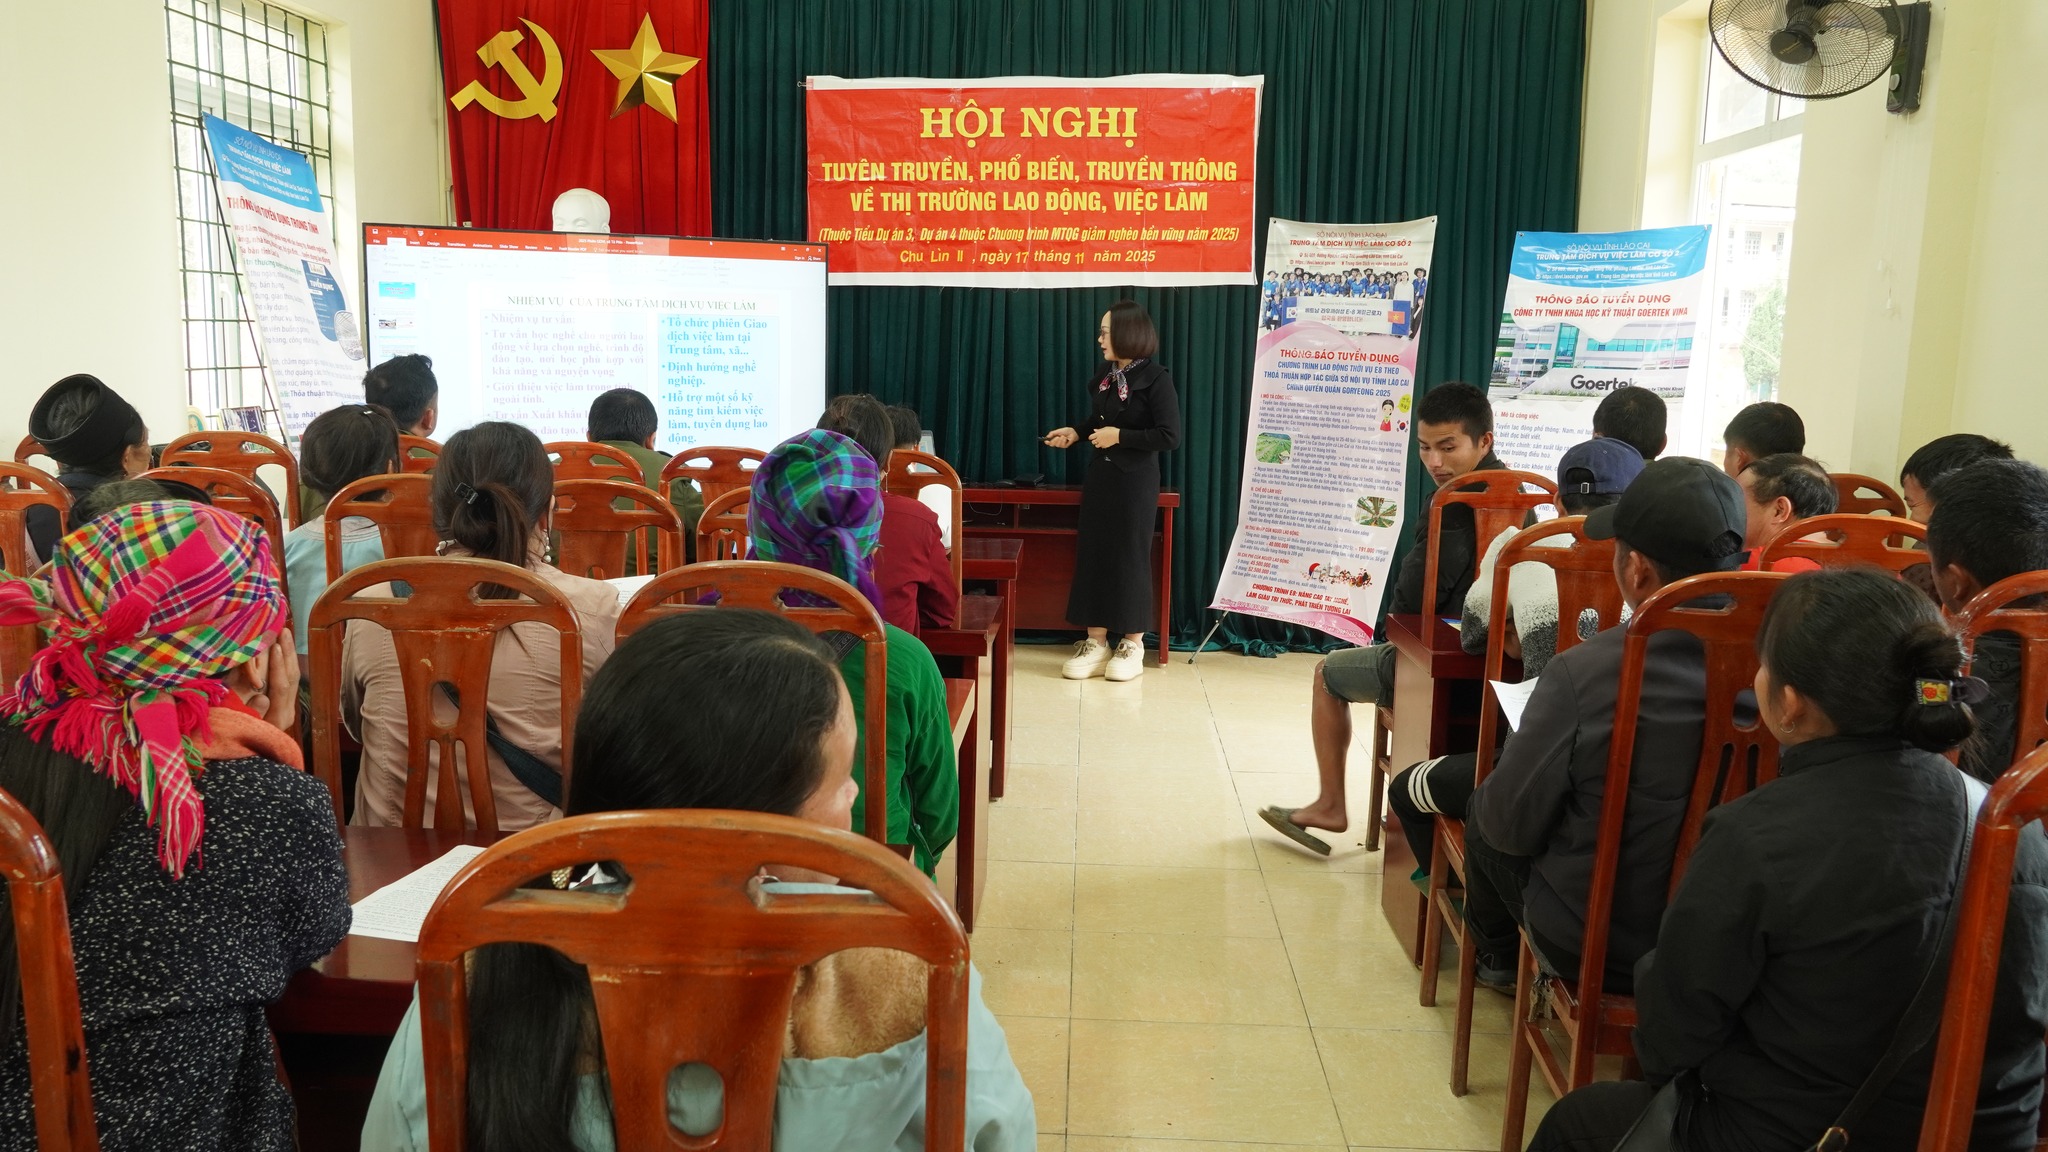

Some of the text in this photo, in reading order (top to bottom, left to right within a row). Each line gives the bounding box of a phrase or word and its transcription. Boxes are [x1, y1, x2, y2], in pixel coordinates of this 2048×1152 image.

[920, 98, 1138, 148] HỘI NGHỊ
[822, 154, 1238, 183] TUYÊN TRUYỀN, PHỔ BIẾN, TRUYỀN THÔNG
[850, 187, 1208, 215] VỀ THỊ TRƯỜNG LAO ĐỘNG, VIỆC LÀM
[819, 225, 1240, 243] (Thuộc Tiểu Dự án 3, Dự án 4 thuộc Chương trình MTQG giảm nghèo bền vững năm 2025)
[900, 250, 923, 263] Chu
[930, 247, 950, 263] Lìn
[980, 250, 1012, 264] ngày
[1015, 251, 1029, 264] 17
[1033, 249, 1070, 265] tháng
[1074, 253, 1084, 264] 11
[1094, 249, 1121, 262] năm
[1125, 251, 1156, 262] 2025
[1535, 290, 1671, 306] THÔNG BÁO TUYỂN DỤNG
[492, 313, 524, 325] Nhiệm
[527, 316, 539, 325] vụ
[1514, 307, 1533, 317] CÔNG
[1534, 308, 1543, 317] TY
[1544, 308, 1563, 317] TNHH
[1564, 309, 1584, 318] KHOA
[1585, 308, 1600, 319] HỌC
[1613, 308, 1637, 319] THUẬT
[1637, 307, 1670, 317] GOERTEK
[1672, 307, 1688, 316] VINA
[668, 315, 768, 330] Tổ chức phiên Giao
[493, 330, 507, 340] Tư
[510, 328, 528, 340] vấn
[532, 331, 549, 342] học
[552, 329, 576, 342] nghề
[579, 331, 597, 340] cho
[630, 332, 644, 341] lao
[668, 332, 751, 344] dịch việc làm tại
[668, 345, 749, 357] Trung tâm, xã...
[1280, 347, 1399, 366] THÔNG BÁO TUYỂN DỤNG
[668, 360, 757, 374] Định hướng nghề
[1278, 360, 1301, 370] CHƯƠNG
[1302, 360, 1319, 371] TRÌNH
[1320, 362, 1331, 371] LAO
[1332, 362, 1348, 373] ĐỘNG
[1384, 366, 1400, 374] THEO
[668, 376, 707, 388] nghiệp.
[1280, 371, 1299, 382] THUẬN
[1570, 374, 1638, 391] Goertek
[668, 390, 754, 404] Hỗ trợ một số kỹ
[1341, 386, 1374, 396] GORYEONG
[1375, 388, 1391, 396] 2025
[668, 404, 764, 417] năng tìm kiếm việc
[1516, 412, 1528, 420] công
[1529, 412, 1539, 420] việc
[668, 417, 768, 431] làm, tuyển dụng lao
